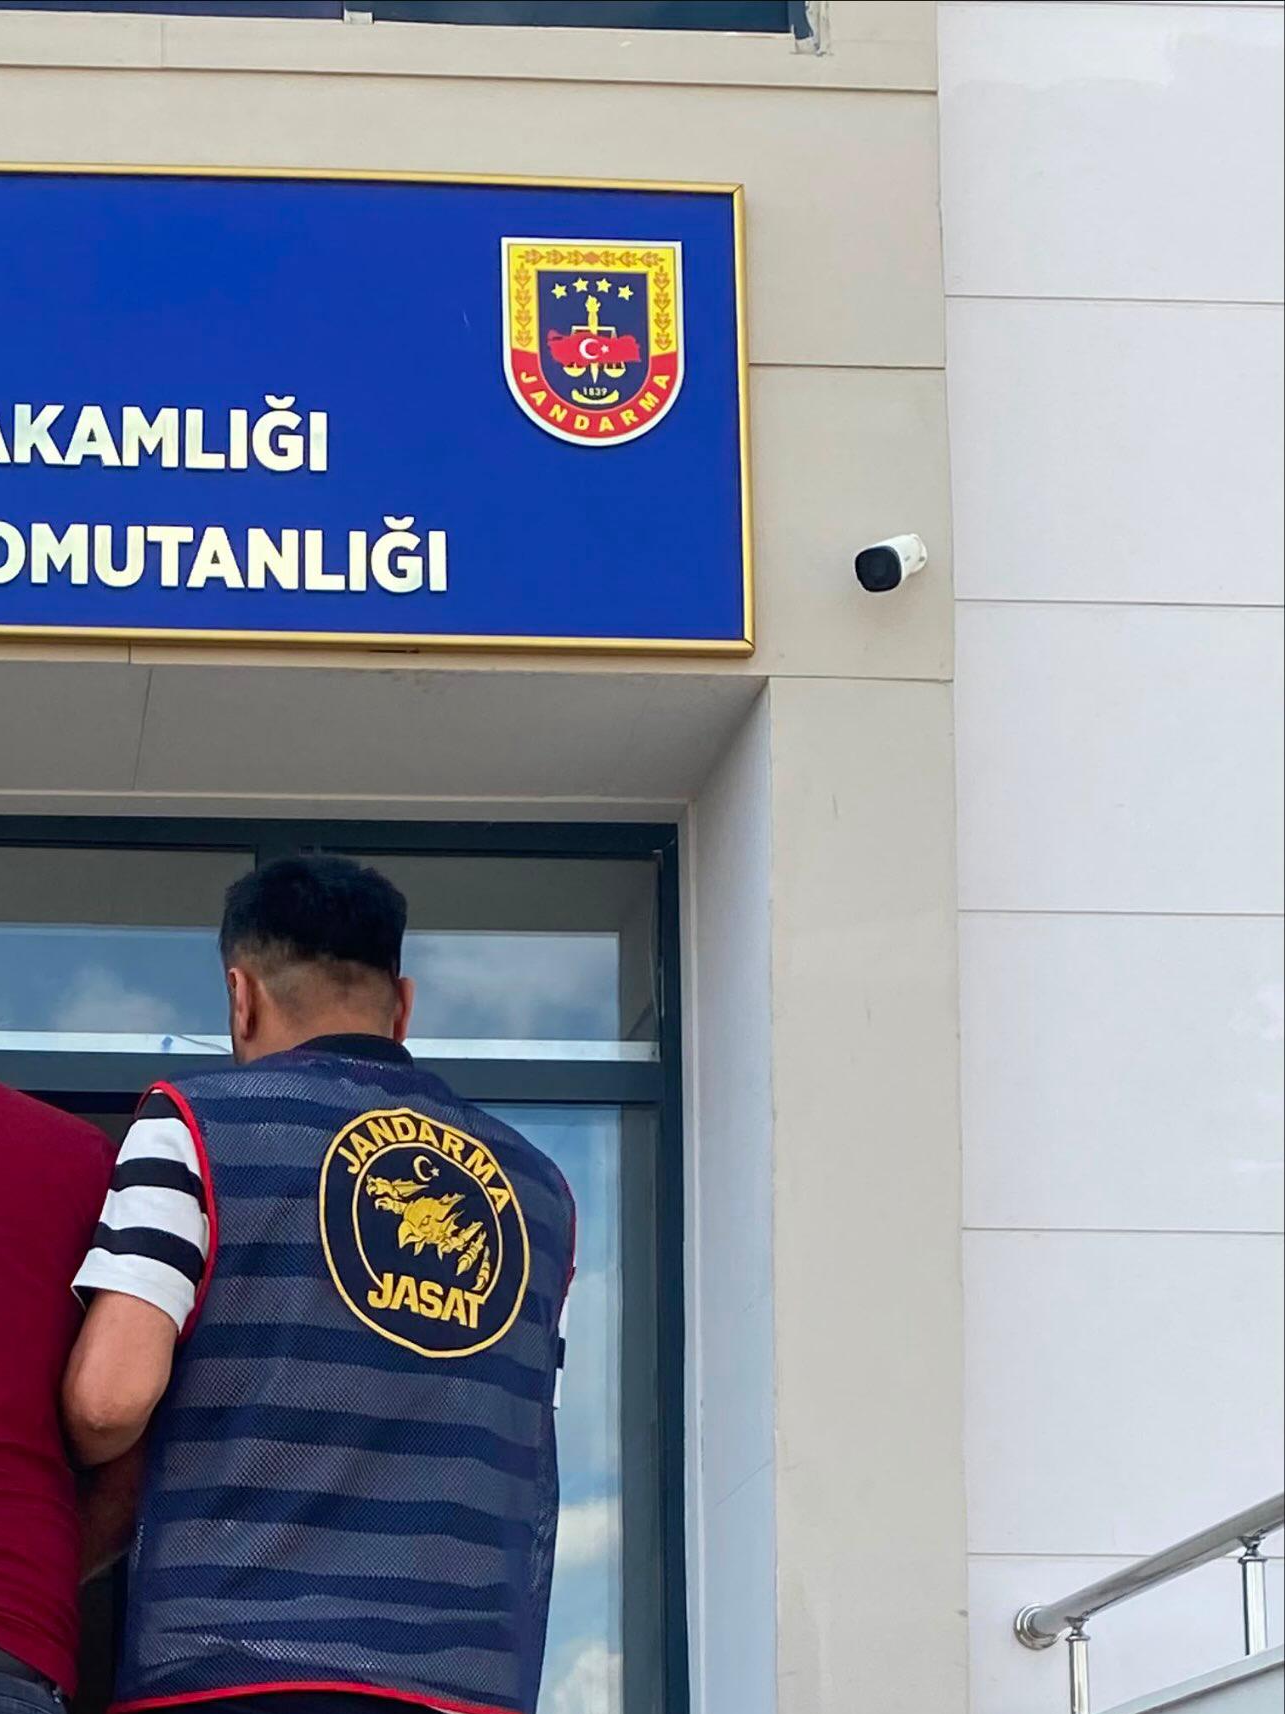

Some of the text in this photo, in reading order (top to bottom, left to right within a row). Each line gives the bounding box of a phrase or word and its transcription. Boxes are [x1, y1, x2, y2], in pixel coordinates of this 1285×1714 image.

[520, 371, 670, 432] JANDARMA
[582, 386, 608, 397] 1839
[337, 1115, 510, 1214] JANDARMA
[367, 1272, 487, 1329] JASAT
